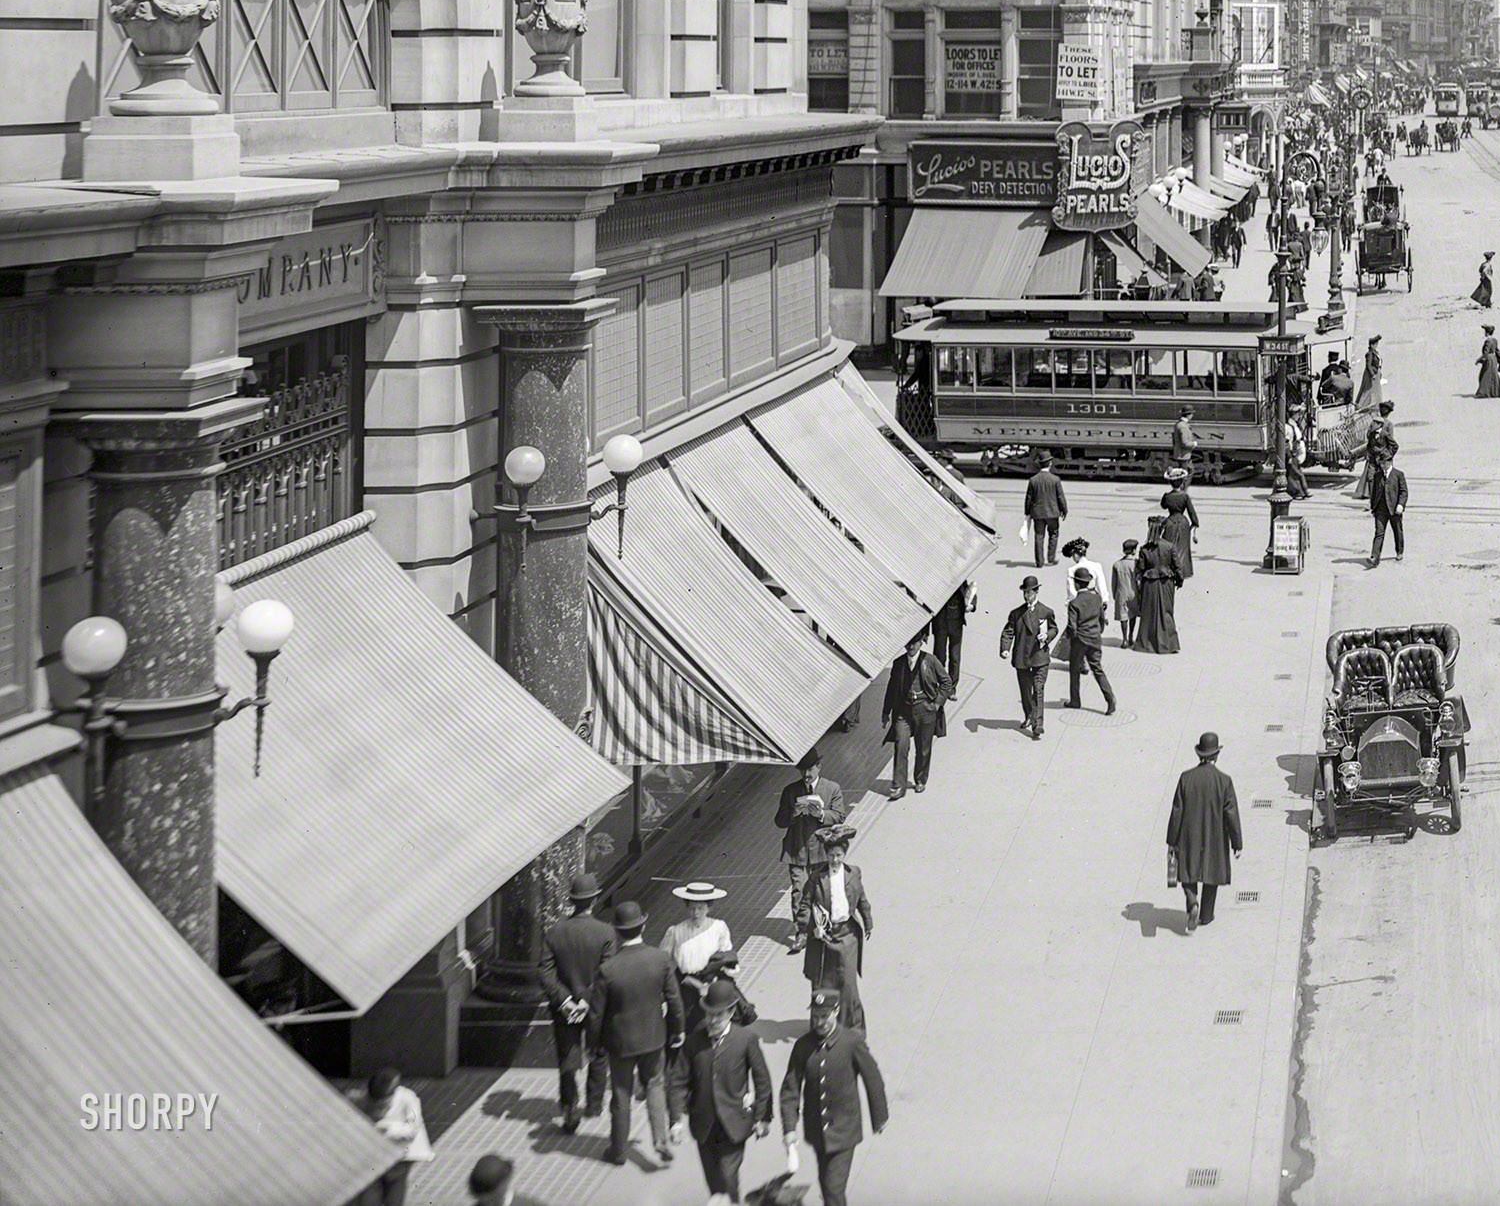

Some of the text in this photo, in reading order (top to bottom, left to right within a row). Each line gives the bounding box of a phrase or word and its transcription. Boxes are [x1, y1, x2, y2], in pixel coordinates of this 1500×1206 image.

[810, 48, 824, 58] TO
[977, 48, 988, 60] TO
[1064, 45, 1093, 53] THESE
[952, 61, 995, 70] FOR OFFICES
[1060, 55, 1098, 64] FLOORS
[1059, 65, 1097, 79] TO LET
[1068, 134, 1132, 190] LUCIOS
[916, 153, 1054, 196] Lucios PEARLS
[972, 181, 1053, 194] DEFY DETECTION
[1066, 194, 1130, 213] PEARLS
[1067, 403, 1121, 414] 1301
